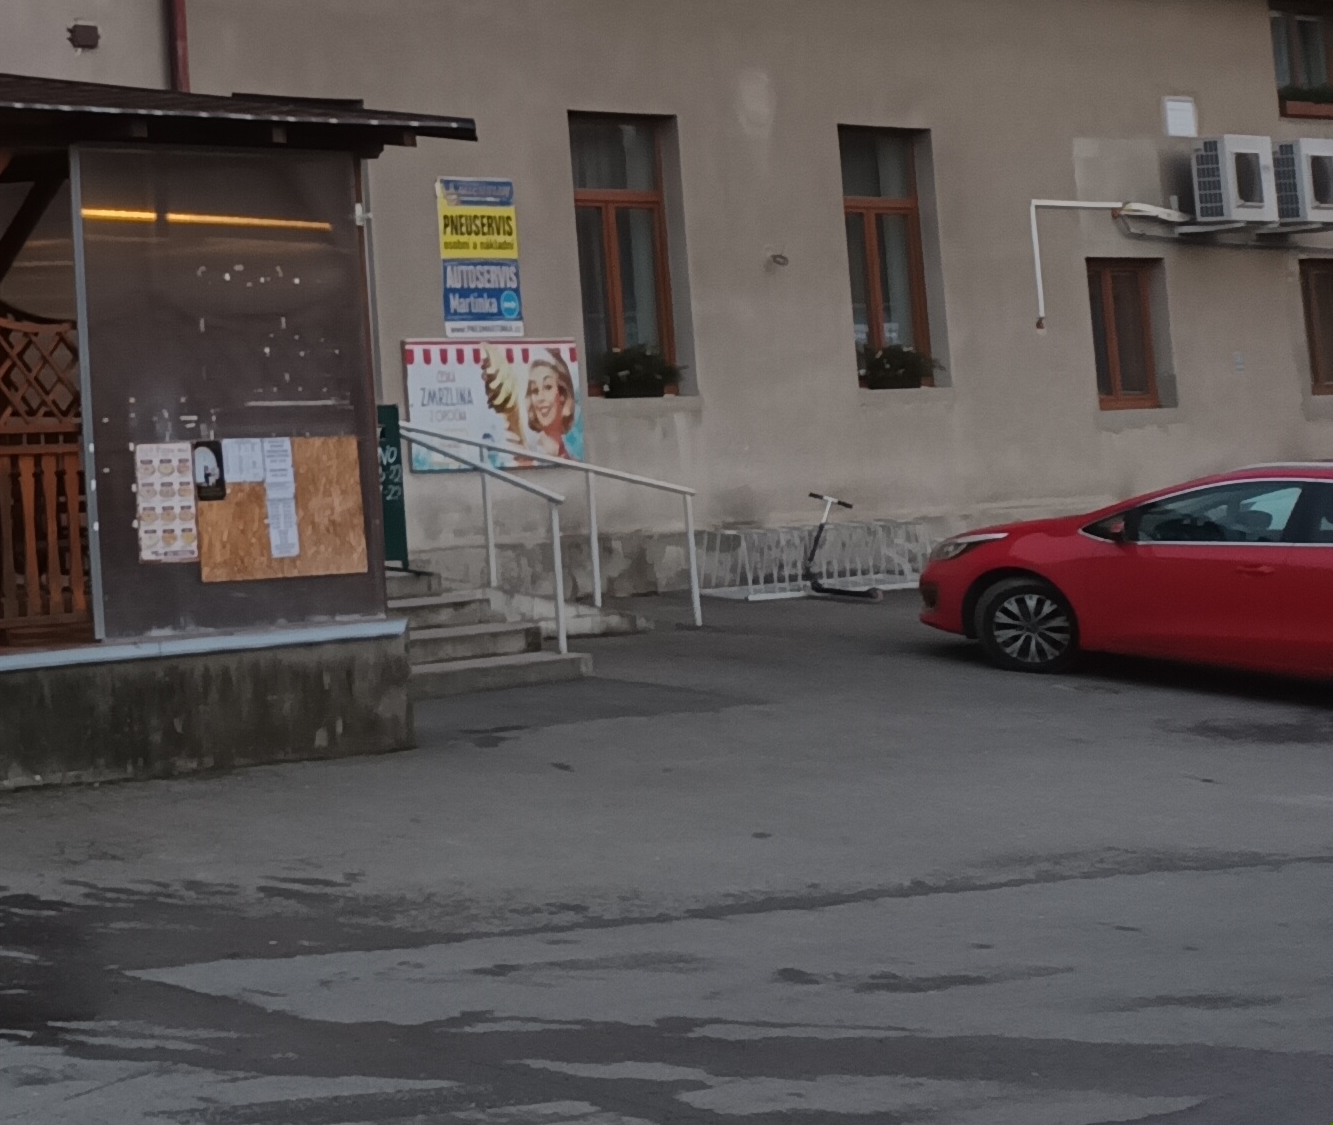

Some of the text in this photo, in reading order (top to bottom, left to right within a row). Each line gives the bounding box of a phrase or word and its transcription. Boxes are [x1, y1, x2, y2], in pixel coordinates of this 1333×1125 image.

[443, 214, 513, 236] PNEUSERVIS
[446, 265, 517, 288] AUTOSERVIS
[449, 292, 498, 313] Martinka
[420, 387, 473, 407] ZMRZLINA
